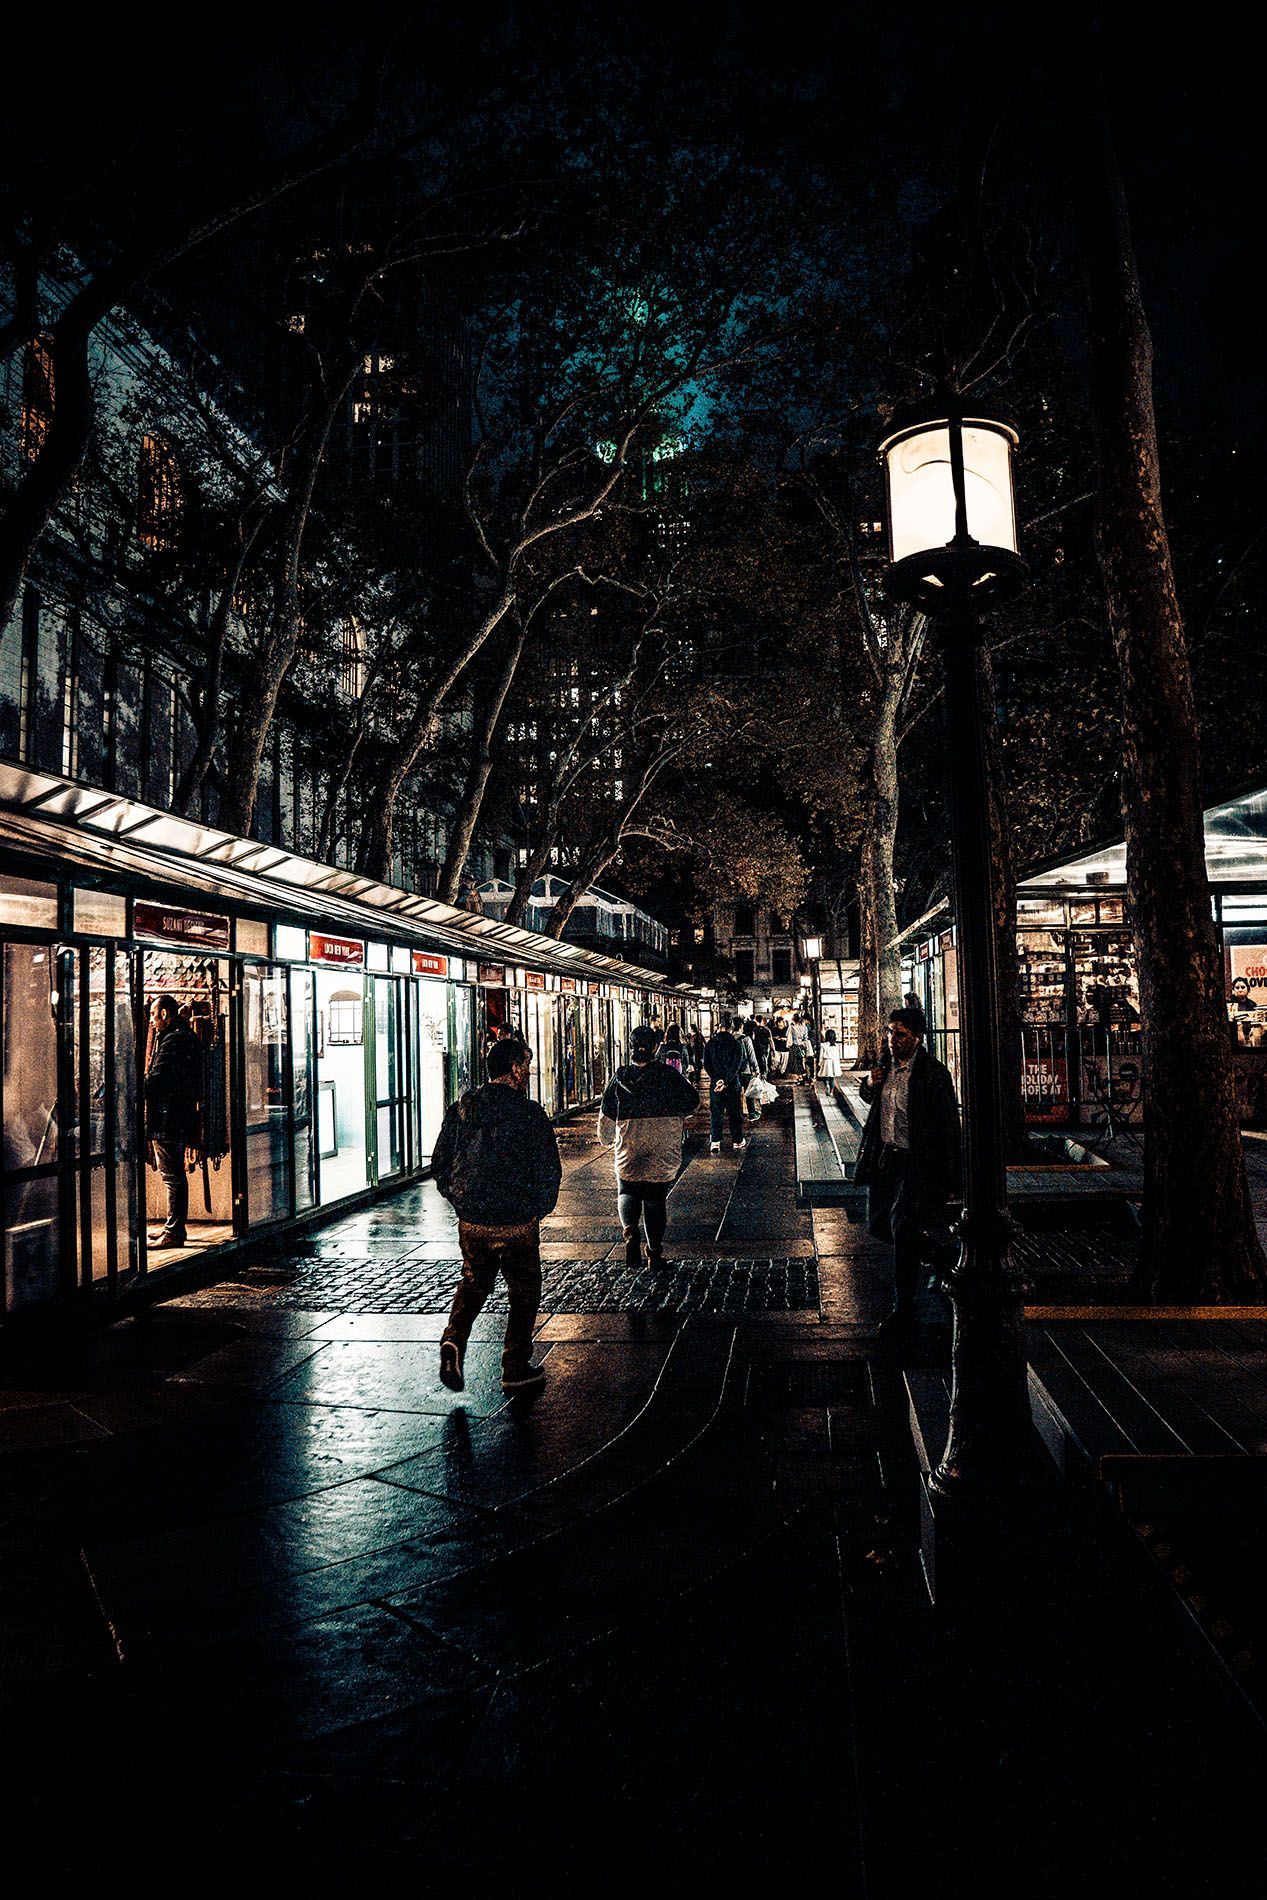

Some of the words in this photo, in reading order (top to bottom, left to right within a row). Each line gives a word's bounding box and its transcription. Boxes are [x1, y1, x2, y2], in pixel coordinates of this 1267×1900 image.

[1245, 966, 1267, 977] CHO
[1028, 1064, 1047, 1074] THE
[1020, 1084, 1048, 1095] HOPS
